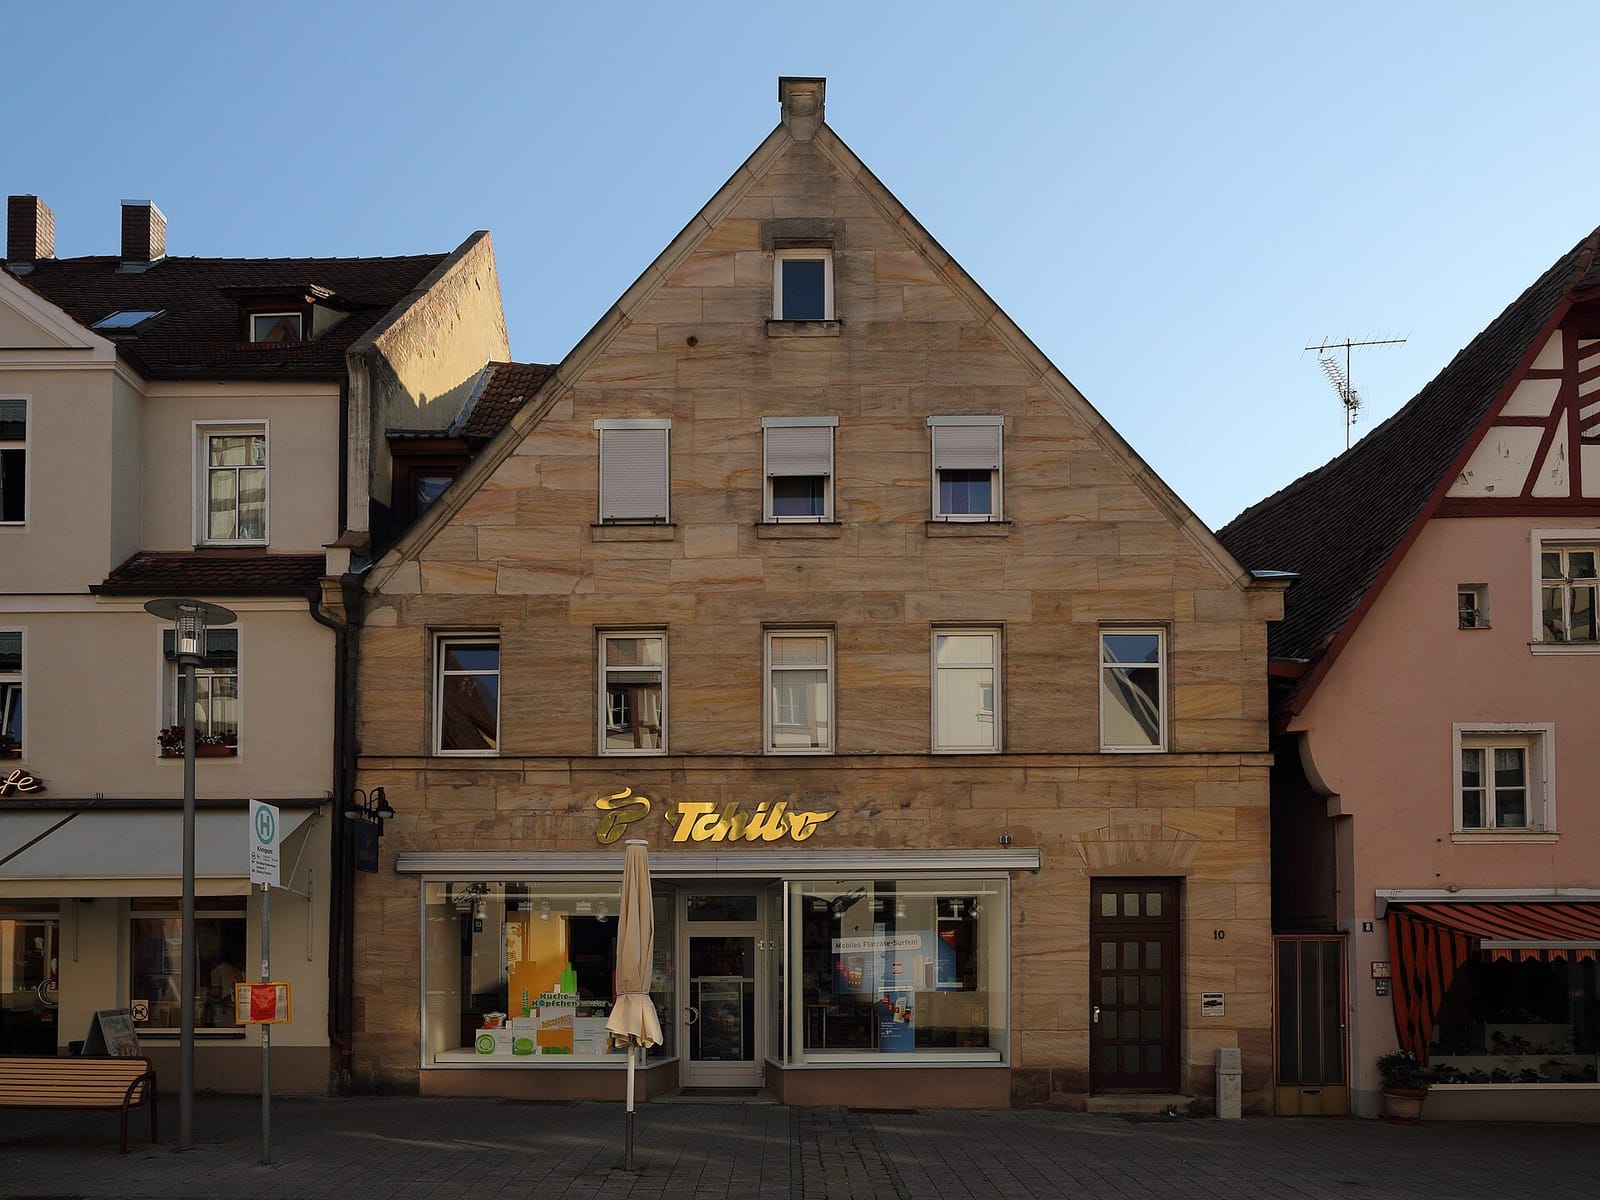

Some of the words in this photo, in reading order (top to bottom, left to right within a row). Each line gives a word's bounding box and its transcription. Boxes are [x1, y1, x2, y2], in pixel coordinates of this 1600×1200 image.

[0, 769, 38, 795] fe
[664, 801, 838, 842] Tchibo
[1213, 930, 1225, 940] 10
[835, 941, 861, 950] Mobiles
